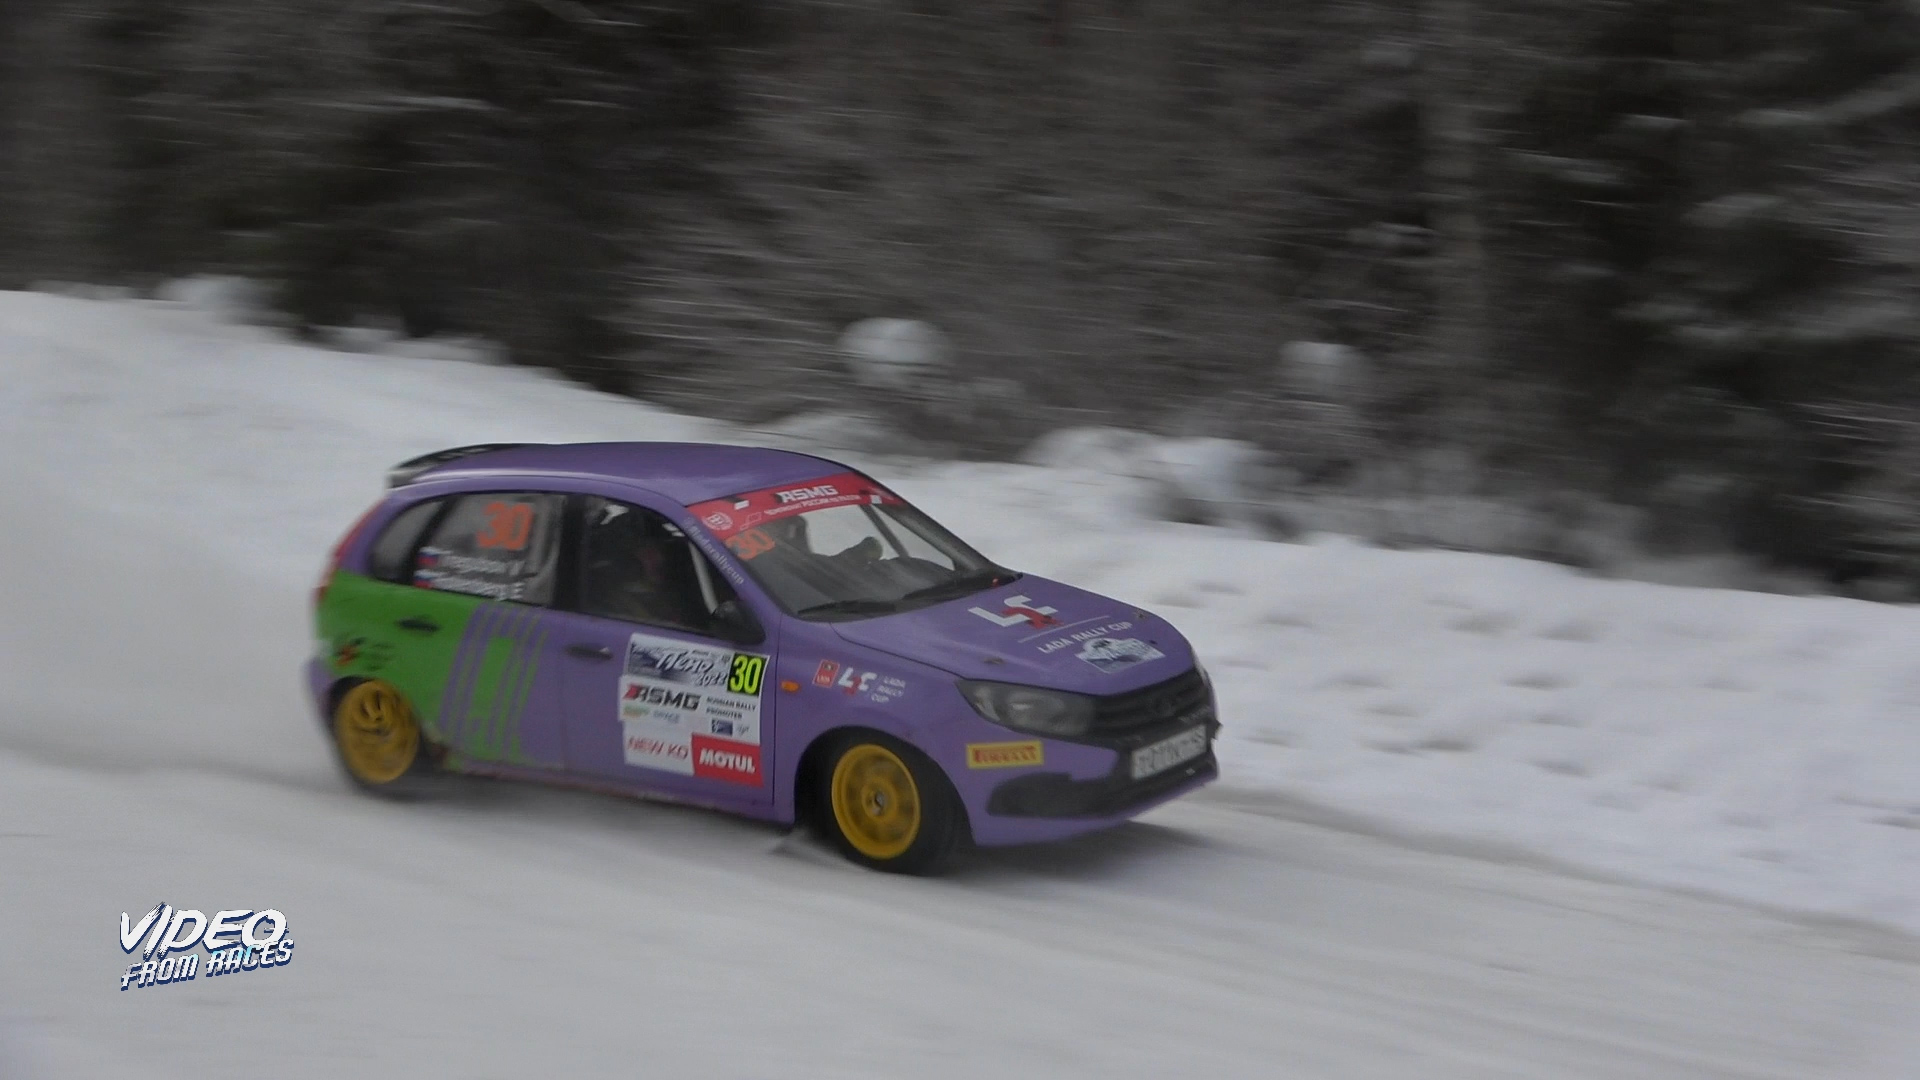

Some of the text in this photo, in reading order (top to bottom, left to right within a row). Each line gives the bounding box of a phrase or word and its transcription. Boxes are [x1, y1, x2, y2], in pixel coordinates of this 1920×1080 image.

[776, 484, 839, 504] ASMG
[476, 501, 535, 551] 30
[723, 527, 777, 561] 30
[1037, 620, 1134, 654] LADA RALLY CUP
[729, 654, 763, 695] 30
[623, 683, 701, 711] ASMG
[735, 702, 757, 713] RALLY
[629, 736, 664, 755] NEW
[699, 748, 756, 774] MOTUL
